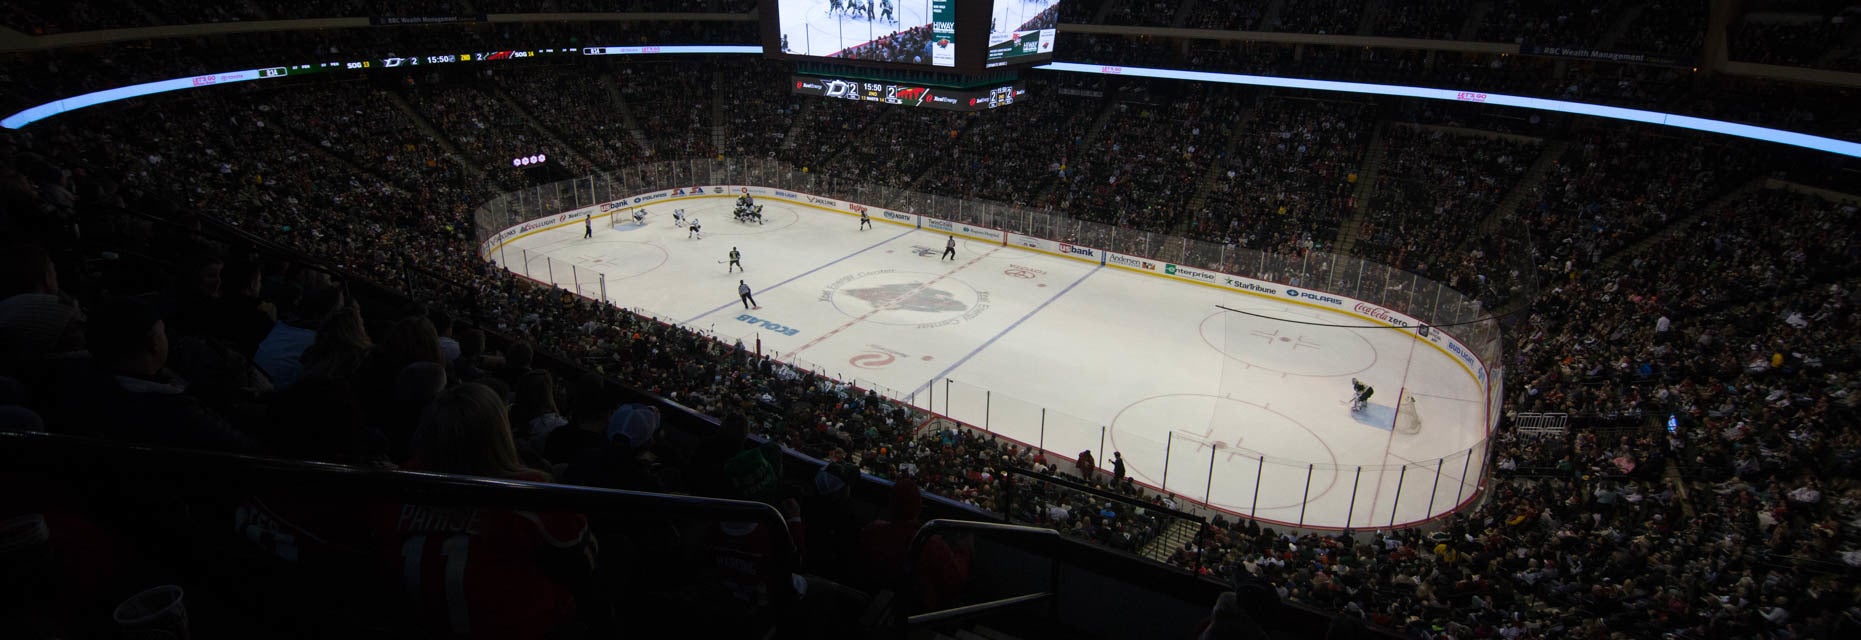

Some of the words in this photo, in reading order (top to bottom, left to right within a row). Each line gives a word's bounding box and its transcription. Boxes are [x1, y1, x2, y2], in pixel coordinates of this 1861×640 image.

[427, 55, 449, 64] 15:50
[346, 62, 362, 70] SOG
[864, 83, 882, 92] 15:50
[1110, 253, 1141, 265] Andersen
[1300, 292, 1343, 305] POLARIS
[735, 314, 801, 337] ECOLAB
[1388, 316, 1408, 328] zero
